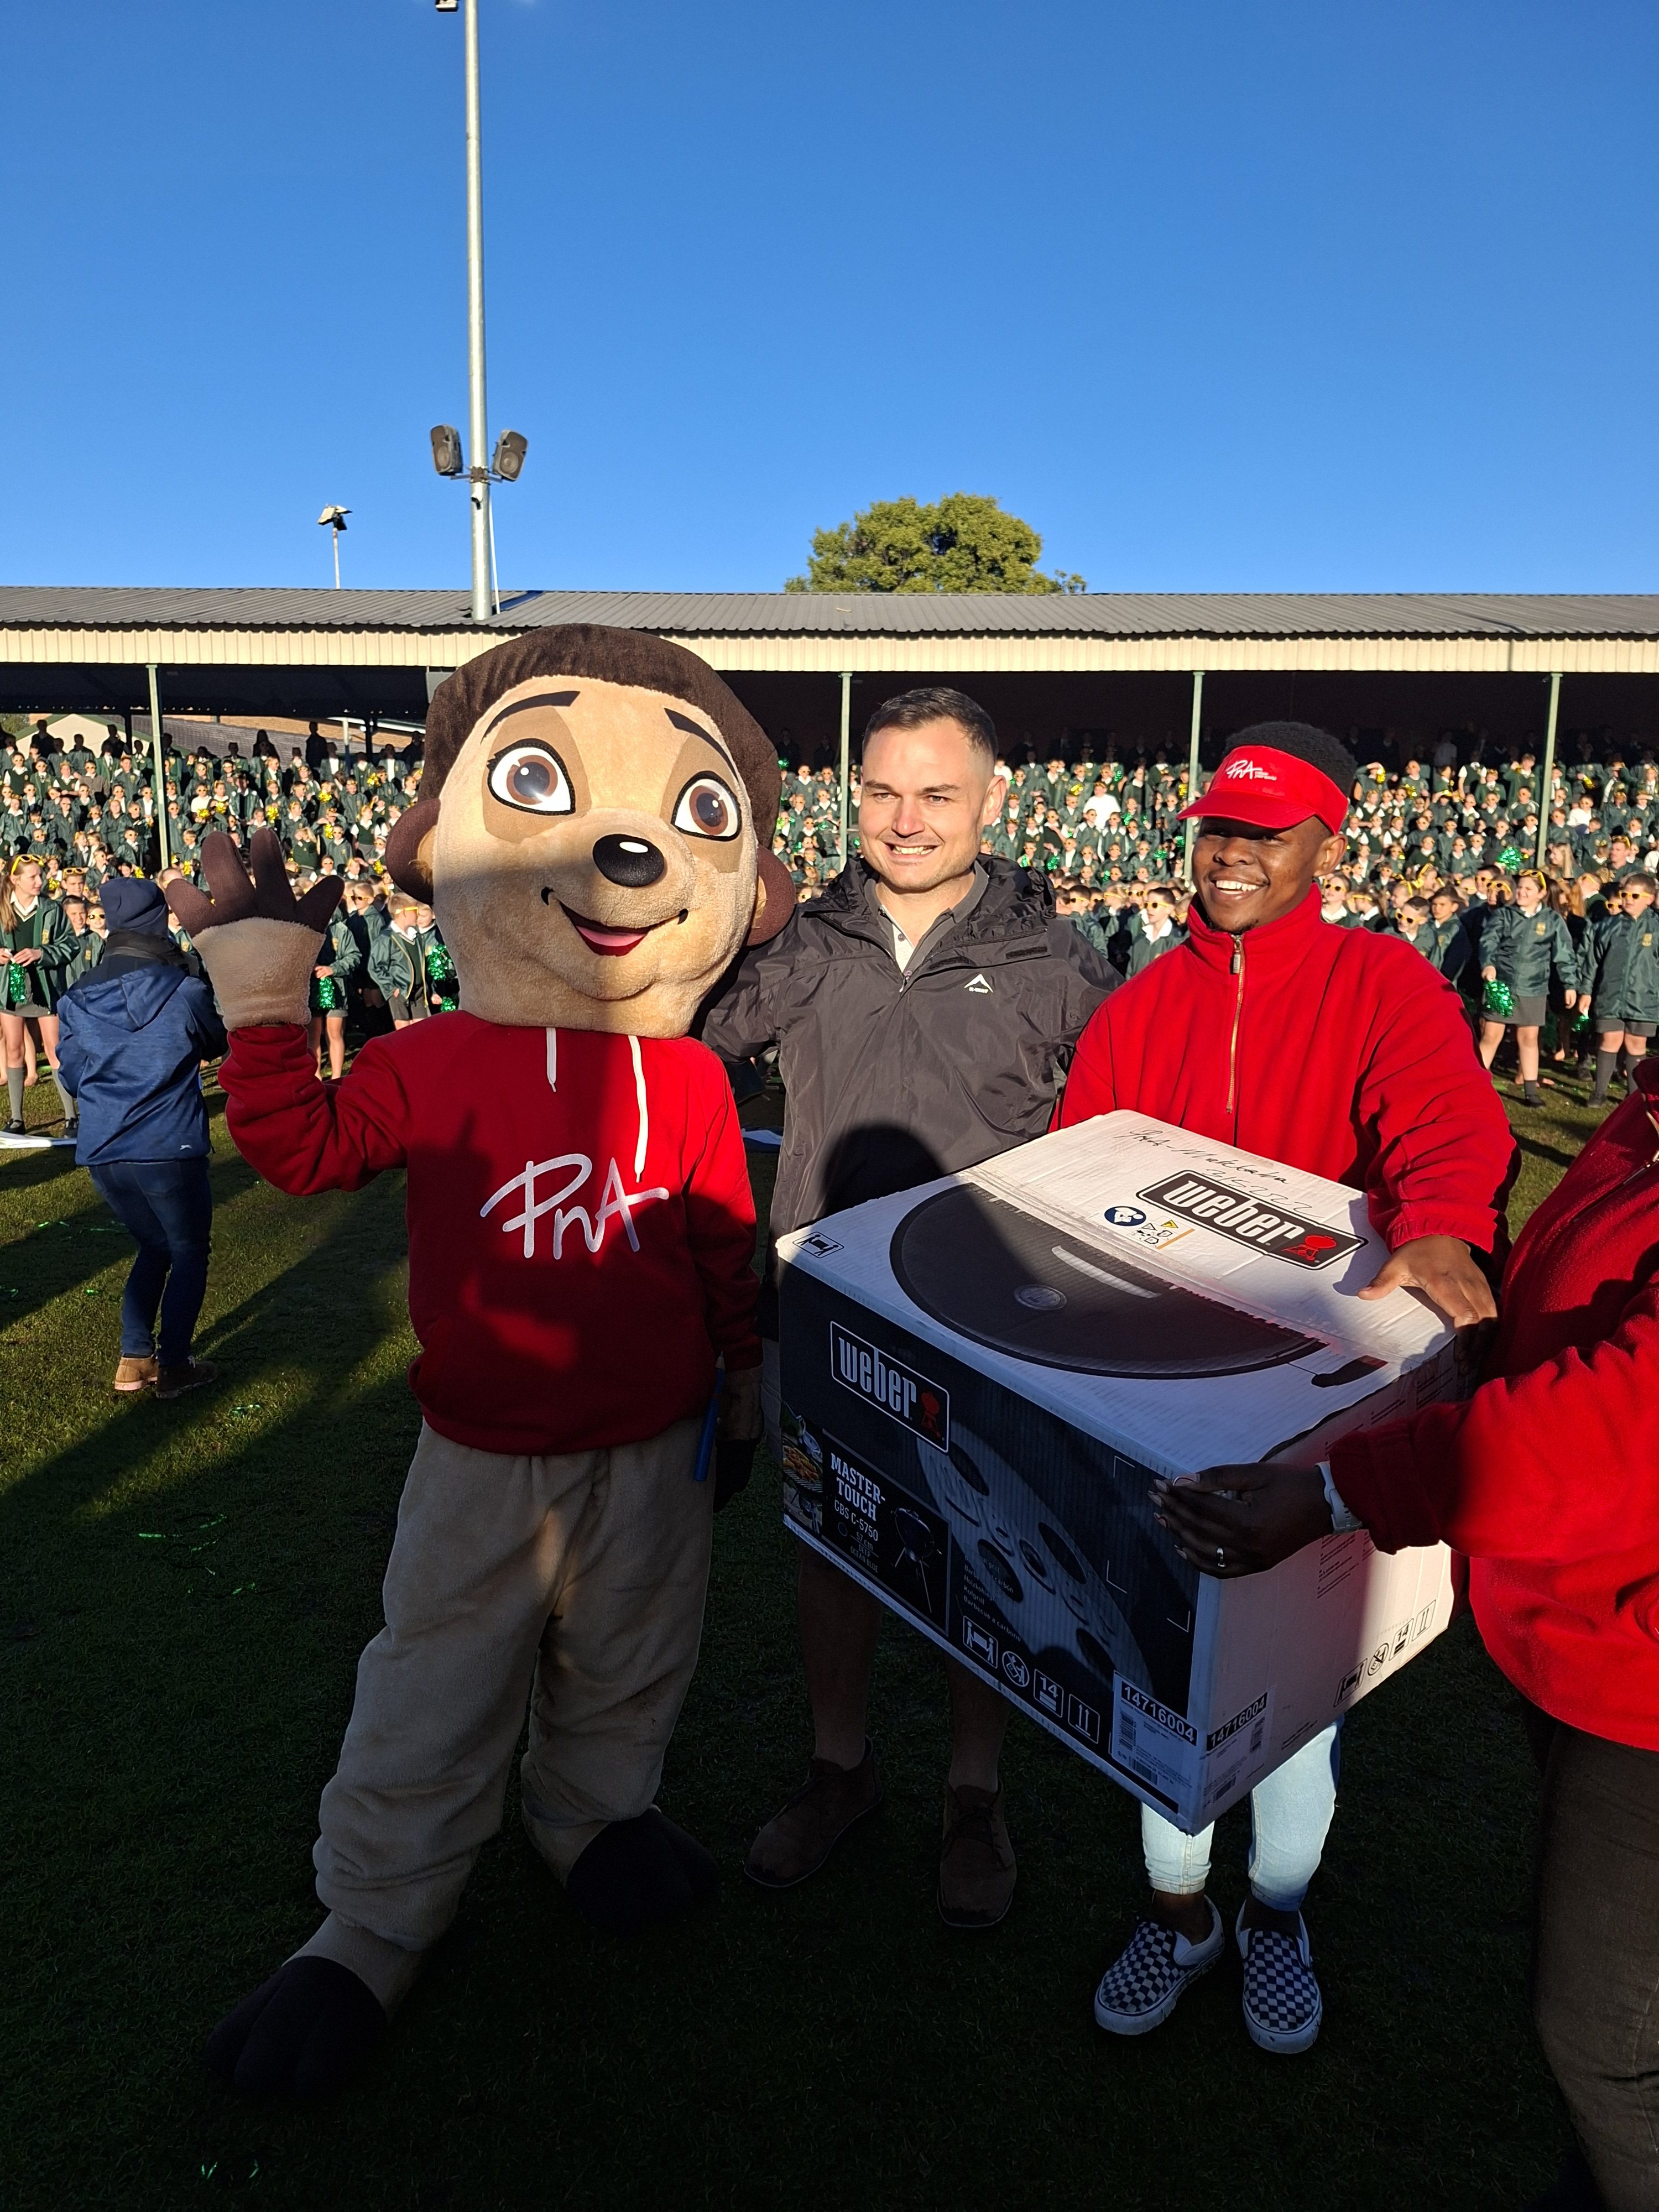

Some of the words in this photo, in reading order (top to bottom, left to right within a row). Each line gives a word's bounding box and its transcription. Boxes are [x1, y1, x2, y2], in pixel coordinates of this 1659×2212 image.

[1162, 1180, 1305, 1245] weber
[838, 1337, 917, 1420] weber
[831, 1452, 885, 1504] MASTER-
[836, 1477, 877, 1521] TOUCH
[851, 1512, 879, 1542] C-5750
[857, 1532, 863, 1543] 57
[864, 1539, 873, 1551] cm
[851, 1546, 866, 1564] OCEAN
[867, 1558, 879, 1573] BLUE
[858, 1545, 871, 1558] DEEP
[963, 1595, 990, 1620] Barbecue
[1040, 1676, 1058, 1698] 14
[1124, 1686, 1195, 1743] 14716004
[1209, 1696, 1266, 1748] 14716004
